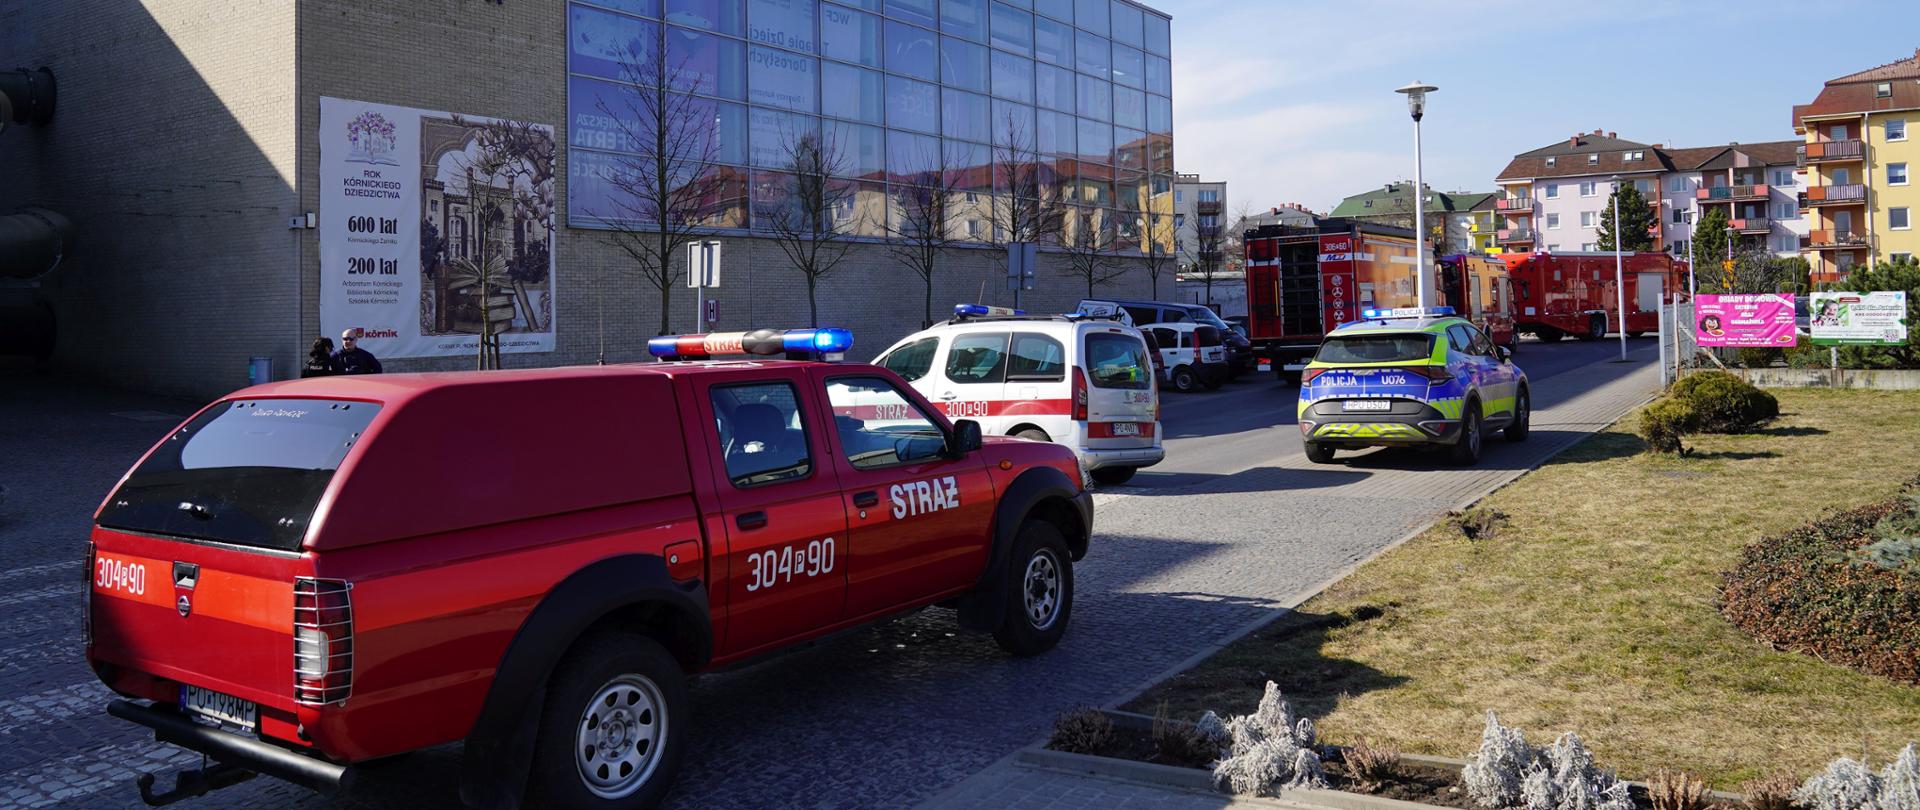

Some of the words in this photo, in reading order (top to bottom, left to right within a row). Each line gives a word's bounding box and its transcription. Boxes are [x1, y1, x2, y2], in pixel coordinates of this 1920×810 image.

[364, 170, 381, 178] ROK
[344, 176, 401, 190] KÓRNICKIEGO
[344, 188, 400, 199] DZIEDZICTWA
[348, 216, 375, 233] 600
[380, 217, 398, 234] lat
[348, 257, 375, 275] 200
[380, 258, 398, 275] lat
[1321, 376, 1357, 386] POLICJA
[1382, 375, 1406, 384] U076
[876, 404, 908, 419] STRAŻ
[890, 476, 959, 519] STRAŻ
[188, 685, 206, 708] PO
[212, 692, 254, 723] 198MP
